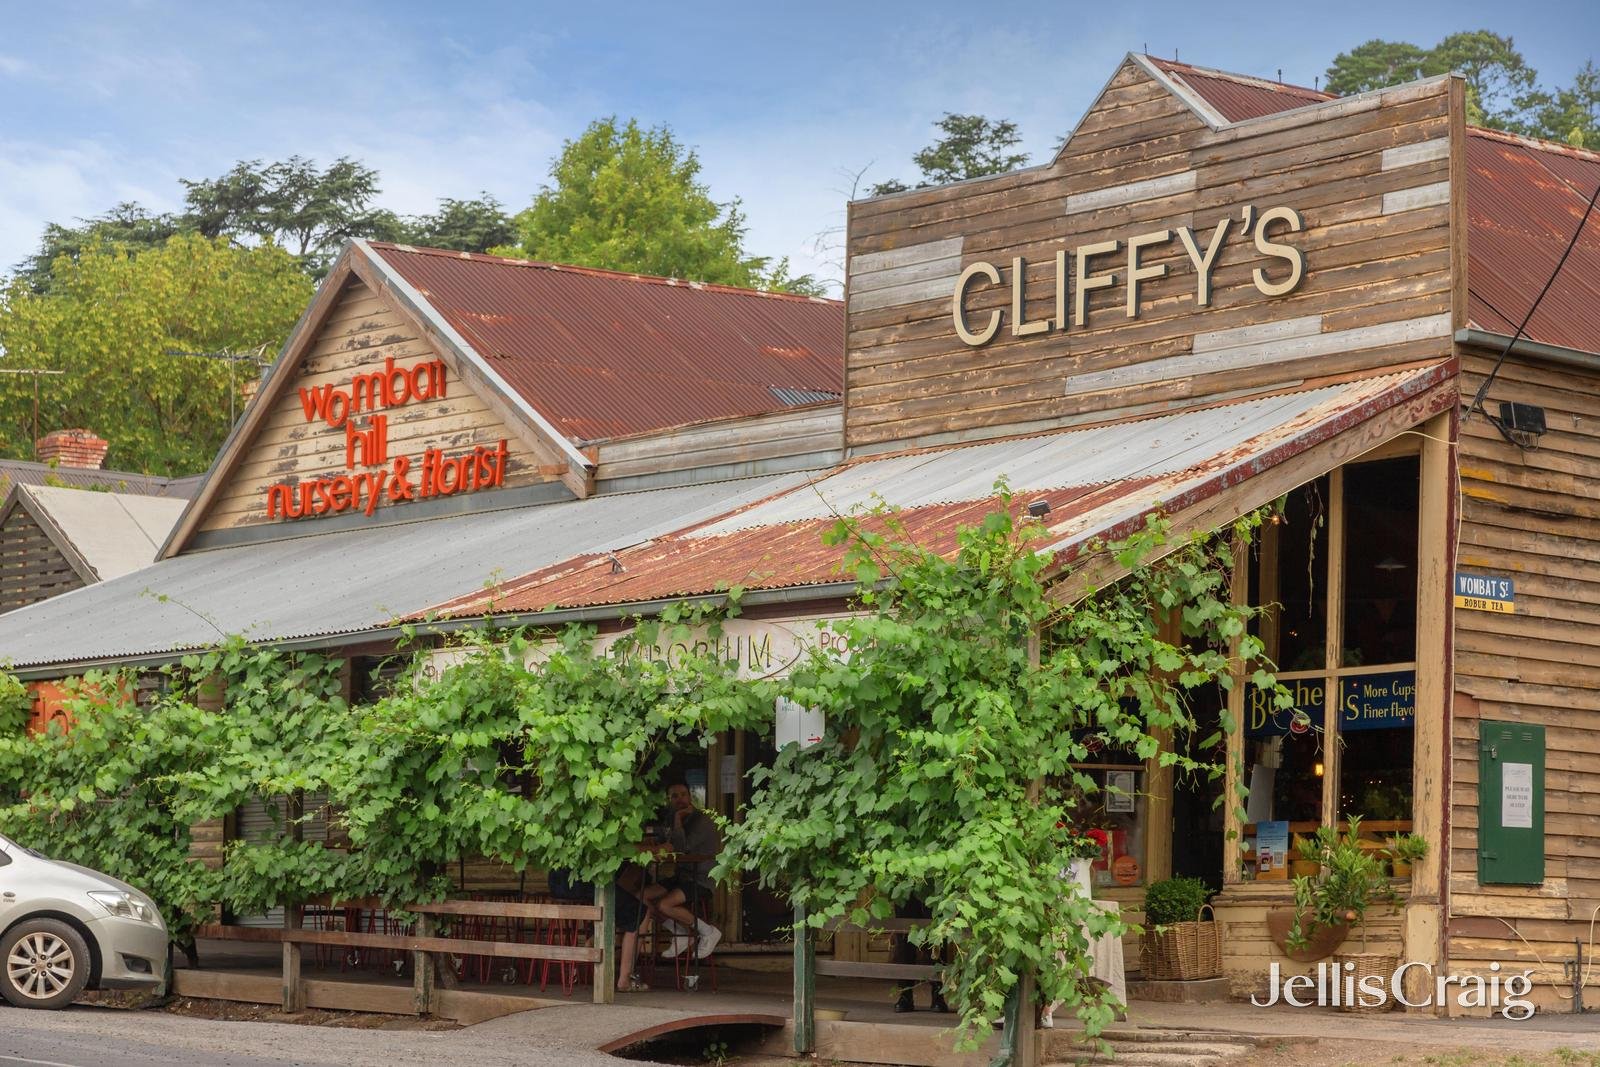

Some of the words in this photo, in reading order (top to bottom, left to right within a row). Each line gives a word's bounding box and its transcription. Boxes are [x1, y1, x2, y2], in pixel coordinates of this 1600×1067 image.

[952, 205, 1305, 347] CLIFFY'S
[299, 357, 447, 427] wombat
[346, 415, 387, 470] hill
[267, 470, 388, 519] nursery
[388, 455, 414, 500] &
[421, 439, 510, 498] florist
[1460, 576, 1497, 597] WOMBAT
[1464, 598, 1487, 609] ROBUR
[1491, 601, 1504, 611] TEA
[1250, 680, 1359, 730] Buhels
[1363, 684, 1388, 698] More
[1392, 680, 1416, 701] Cups
[1363, 705, 1388, 719] Finer
